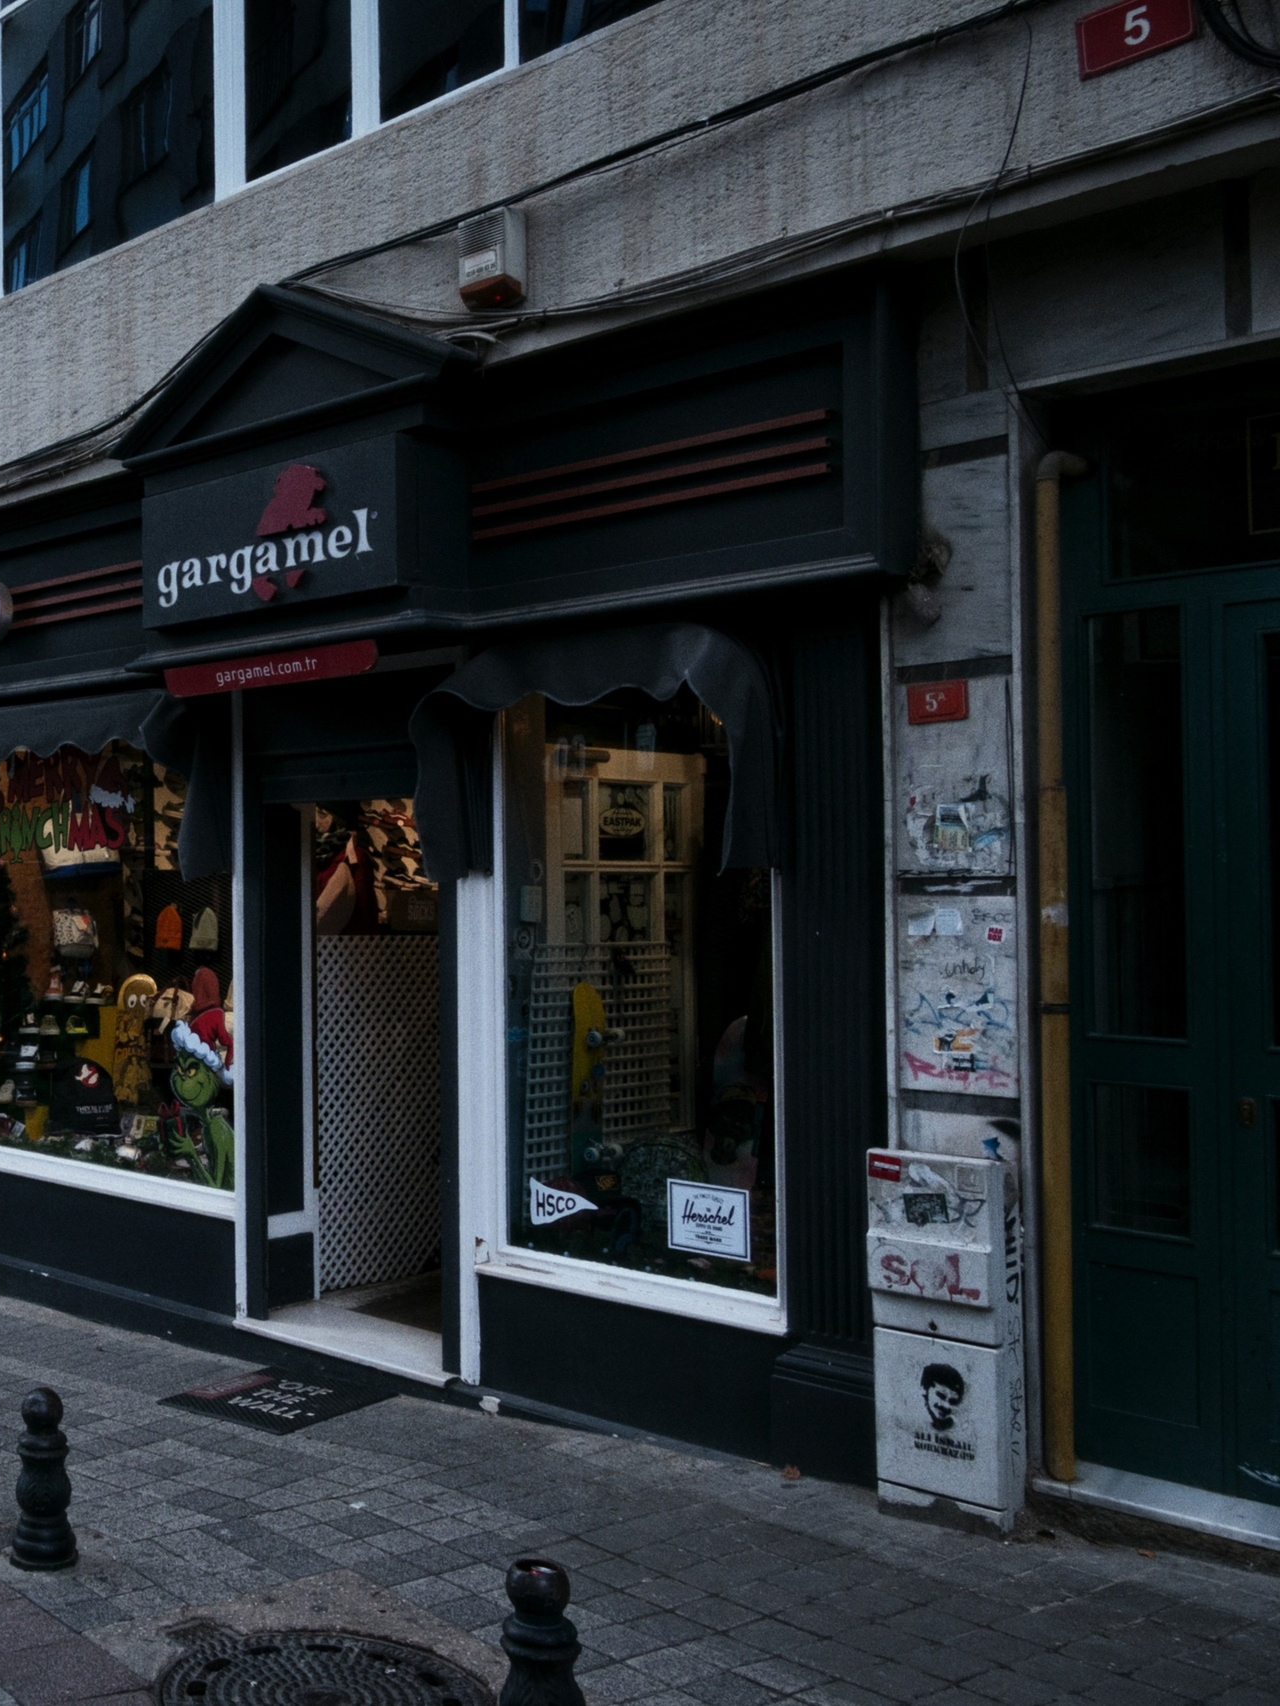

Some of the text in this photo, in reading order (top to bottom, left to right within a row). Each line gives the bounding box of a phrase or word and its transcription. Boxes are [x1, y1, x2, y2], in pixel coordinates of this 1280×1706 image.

[1123, 5, 1151, 46] 5
[157, 507, 374, 609] gargamel
[216, 656, 318, 687] gargamel.com.tr
[8, 746, 102, 803] MERRY
[603, 816, 642, 828] EASTPAK
[536, 1189, 576, 1217] HSCO
[681, 1198, 735, 1227] Herschel
[253, 1388, 306, 1405] THE
